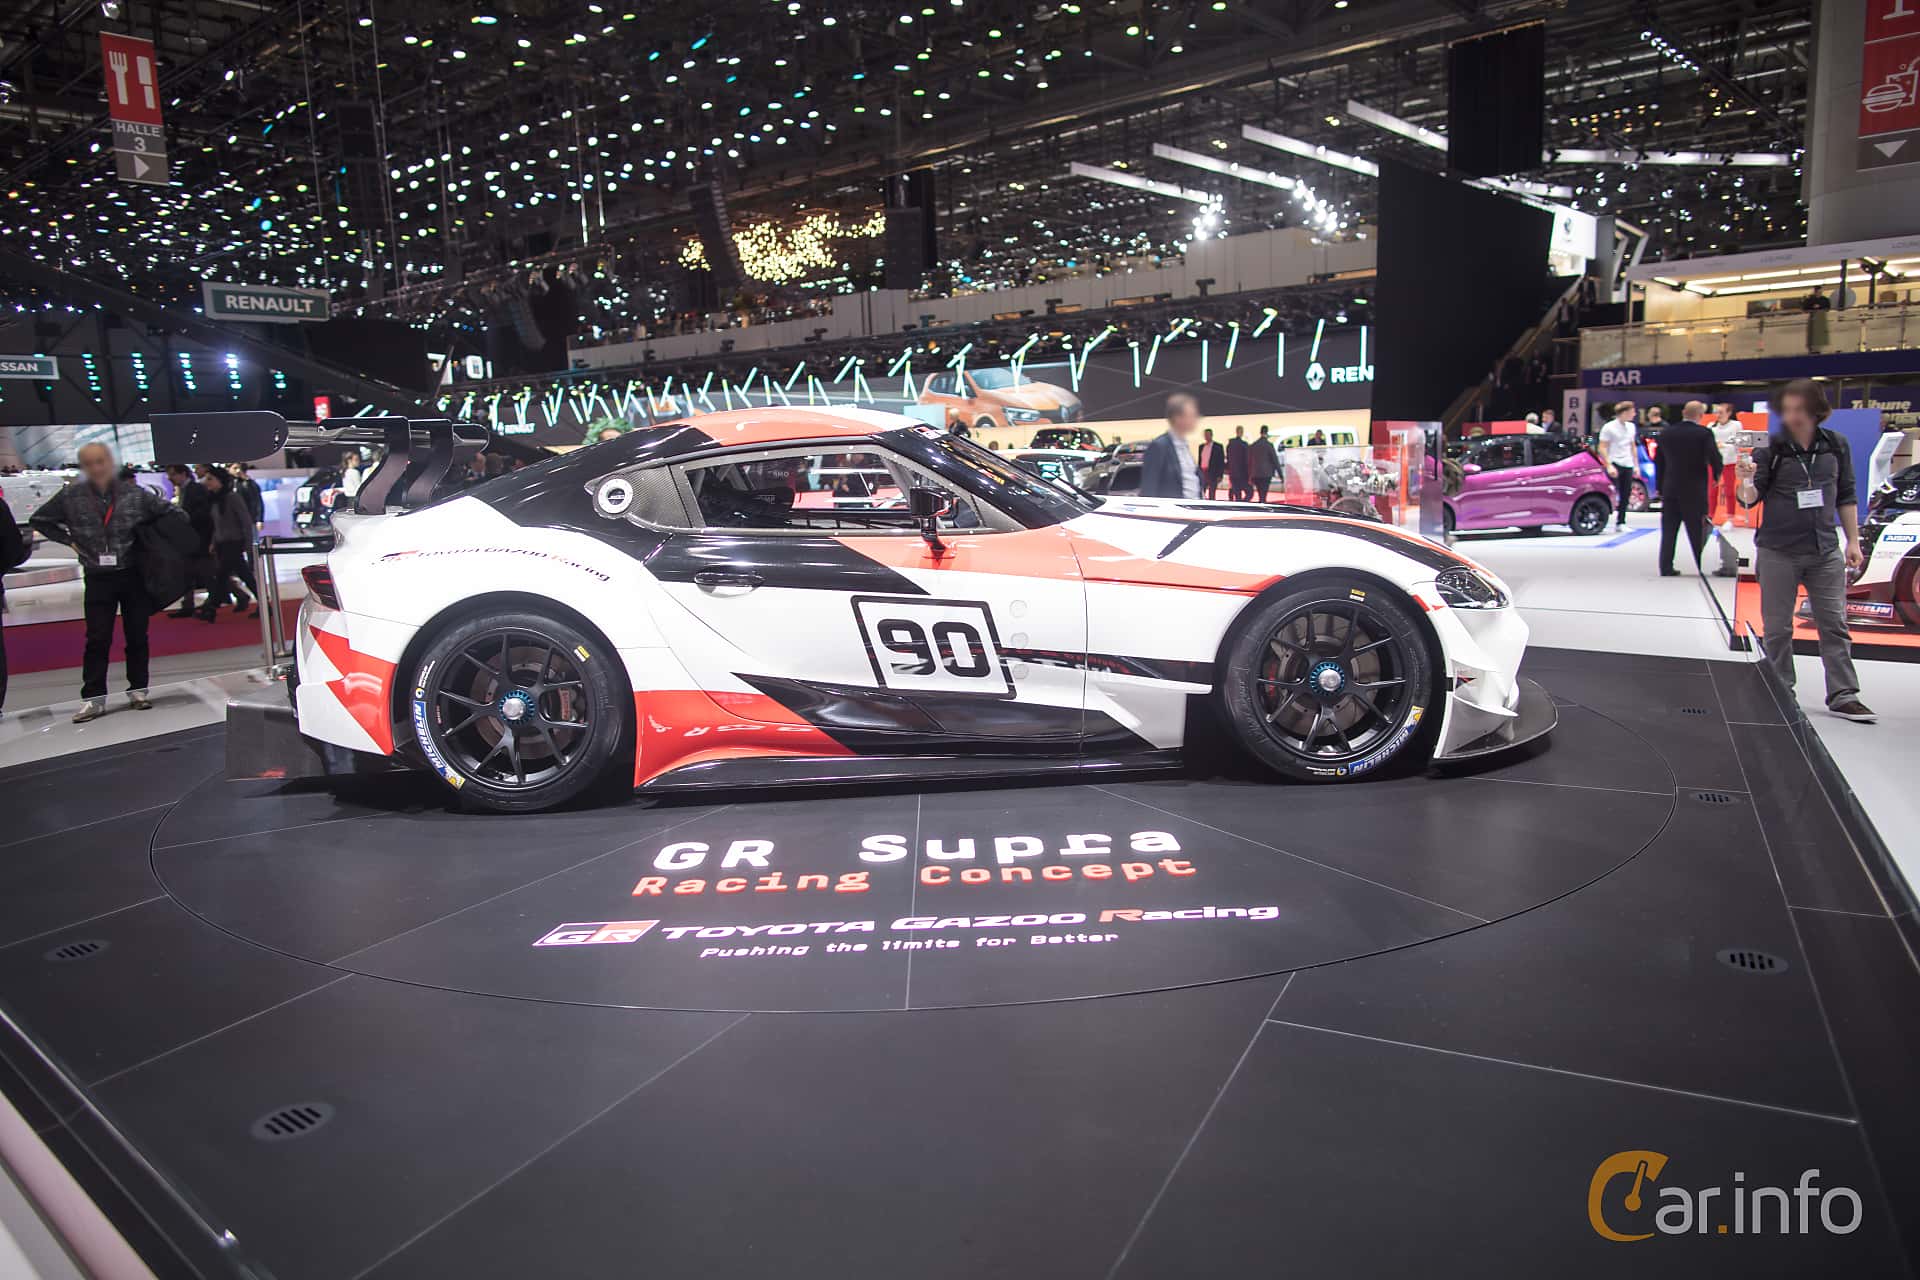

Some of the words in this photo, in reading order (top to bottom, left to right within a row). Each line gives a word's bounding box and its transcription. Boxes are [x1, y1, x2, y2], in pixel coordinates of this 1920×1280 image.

[116, 122, 160, 137] HALLE
[134, 137, 146, 152] 3
[225, 295, 312, 312] RENAULT
[1331, 365, 1374, 383] REN
[1601, 370, 1641, 385] BAR
[1847, 604, 1890, 613] ICHELIN
[878, 619, 992, 678] 90
[414, 702, 444, 770] MICHELIN
[653, 840, 775, 870] GR
[858, 830, 1181, 863] Supra
[632, 872, 870, 896] Racing
[920, 858, 1197, 886] Concept
[543, 928, 642, 944] GR
[661, 921, 876, 940] TOYOTA
[890, 913, 1087, 930] GAZOO
[1099, 906, 1280, 922] Racing
[700, 943, 810, 958] Pushing
[826, 942, 868, 953] the
[881, 938, 960, 951] limits
[975, 936, 1017, 947] for
[1030, 932, 1119, 945] Better
